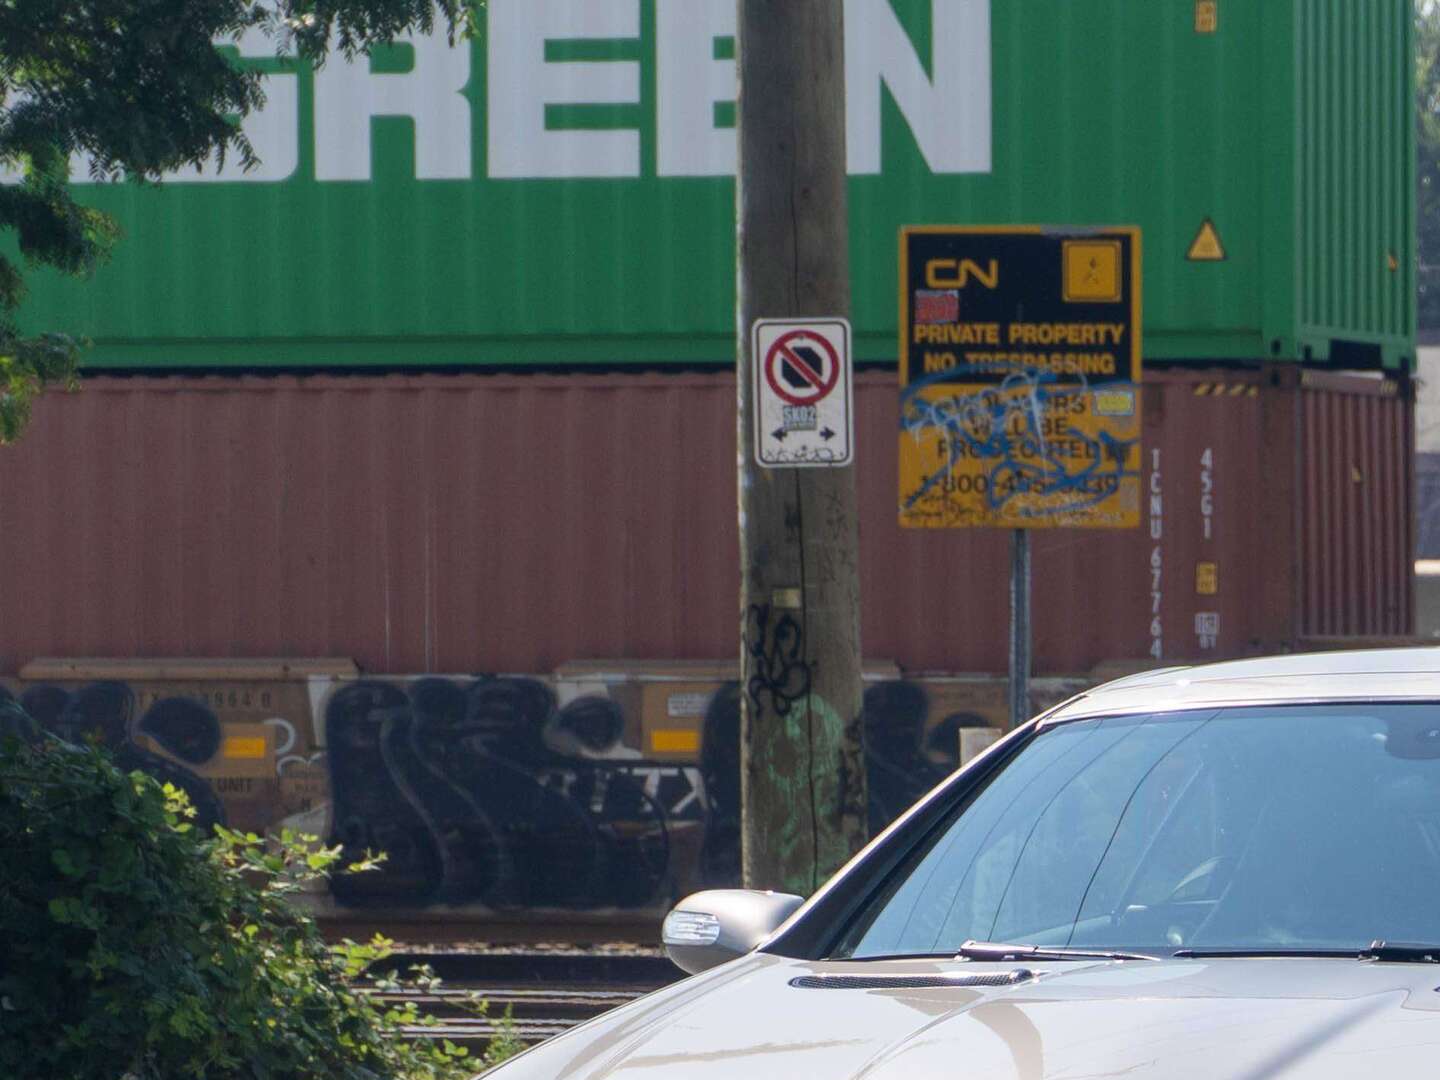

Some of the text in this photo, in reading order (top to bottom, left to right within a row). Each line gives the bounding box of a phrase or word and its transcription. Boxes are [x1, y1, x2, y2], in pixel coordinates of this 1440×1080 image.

[926, 258, 999, 289] CN
[914, 324, 1125, 345] PRIVATE PROPERTY
[924, 352, 956, 374] NO
